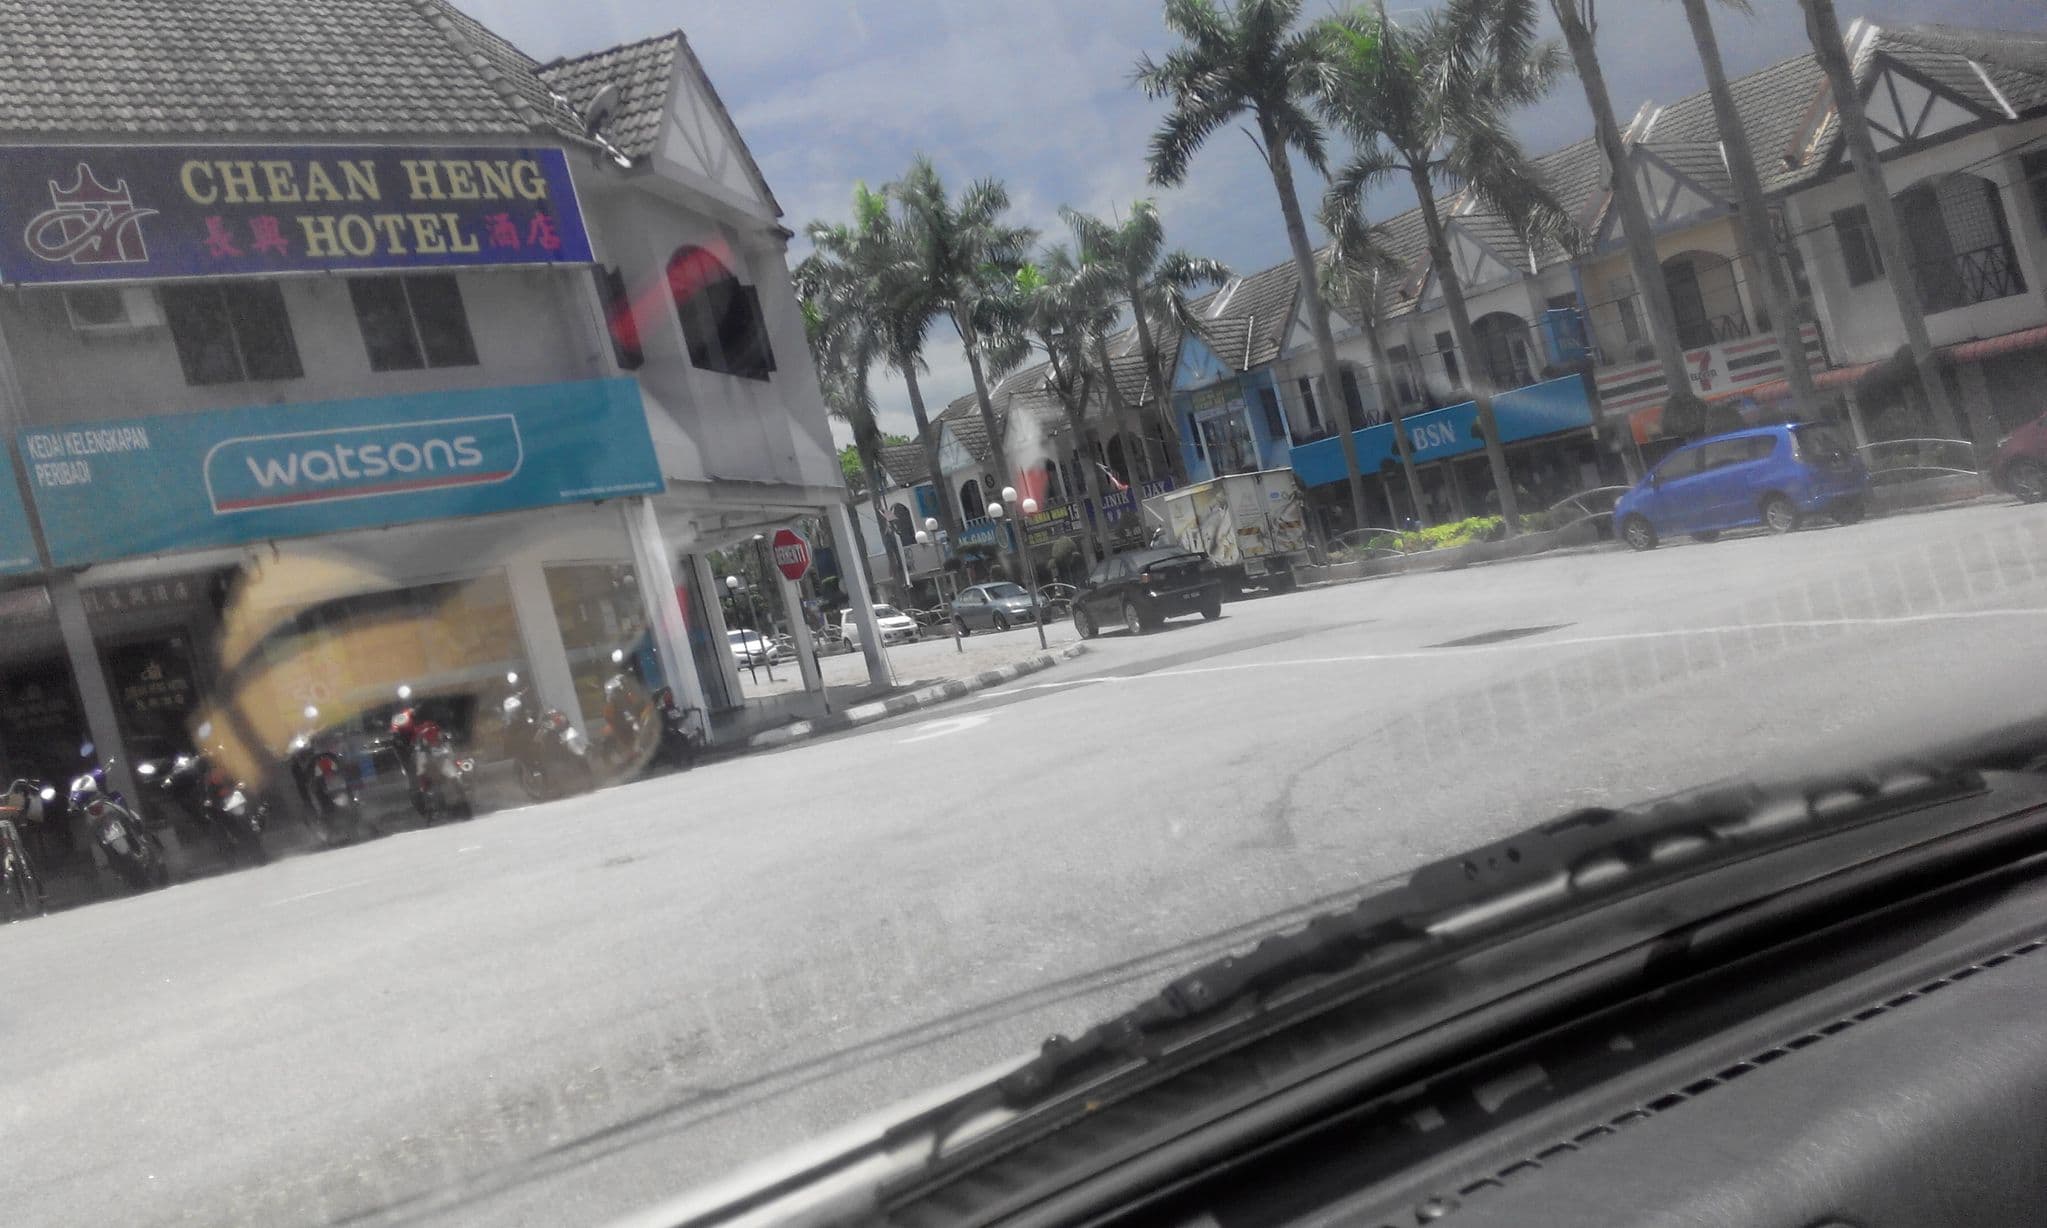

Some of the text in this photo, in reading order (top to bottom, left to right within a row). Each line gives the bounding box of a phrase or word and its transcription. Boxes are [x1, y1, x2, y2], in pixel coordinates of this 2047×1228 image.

[181, 156, 547, 205] CHEAN HENG
[296, 212, 480, 258] HOTEL
[27, 427, 149, 459] KEDAI KELENGKAPAN
[1412, 421, 1454, 452] BSN
[36, 460, 91, 486] PERIBADI
[246, 433, 484, 489] watsons
